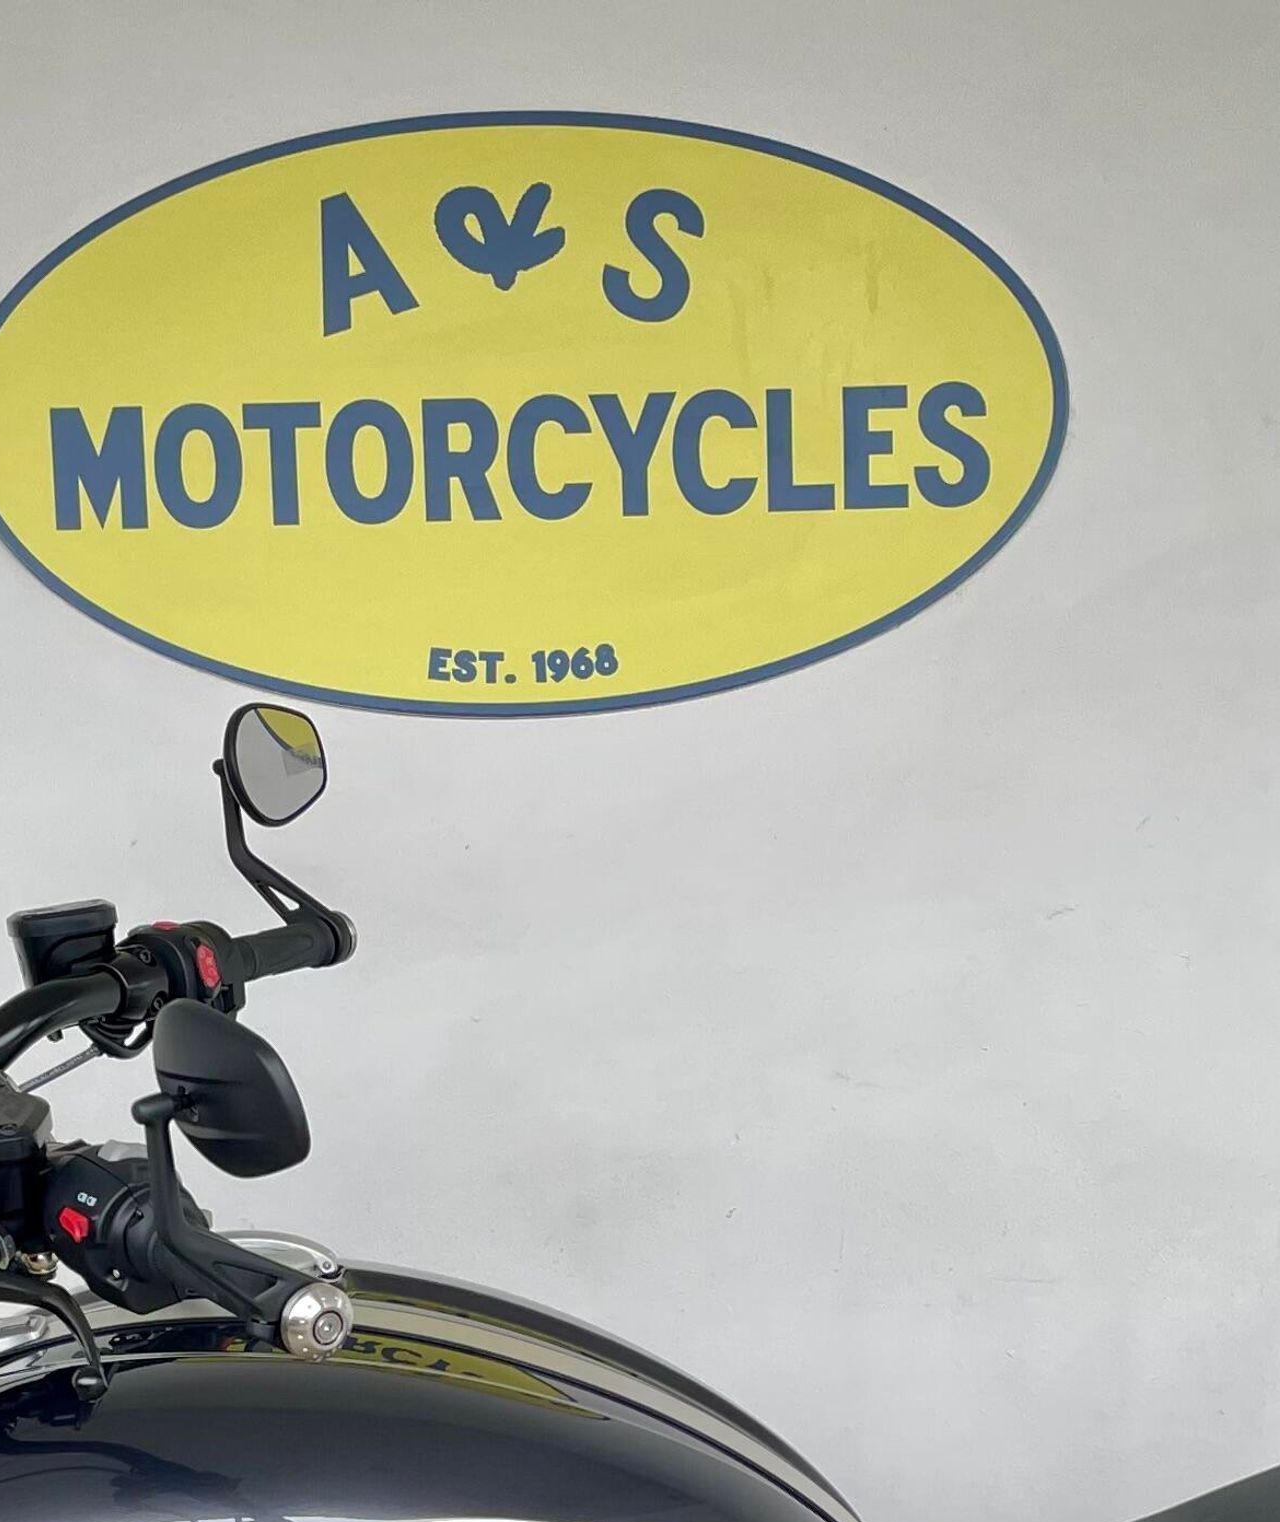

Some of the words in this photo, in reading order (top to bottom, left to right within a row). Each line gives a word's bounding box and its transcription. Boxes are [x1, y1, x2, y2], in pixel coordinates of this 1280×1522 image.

[323, 192, 419, 336] A
[602, 187, 704, 323] S
[49, 381, 991, 531] MOTORCYCLES
[427, 646, 517, 684] EST.
[531, 643, 619, 683] 1968
